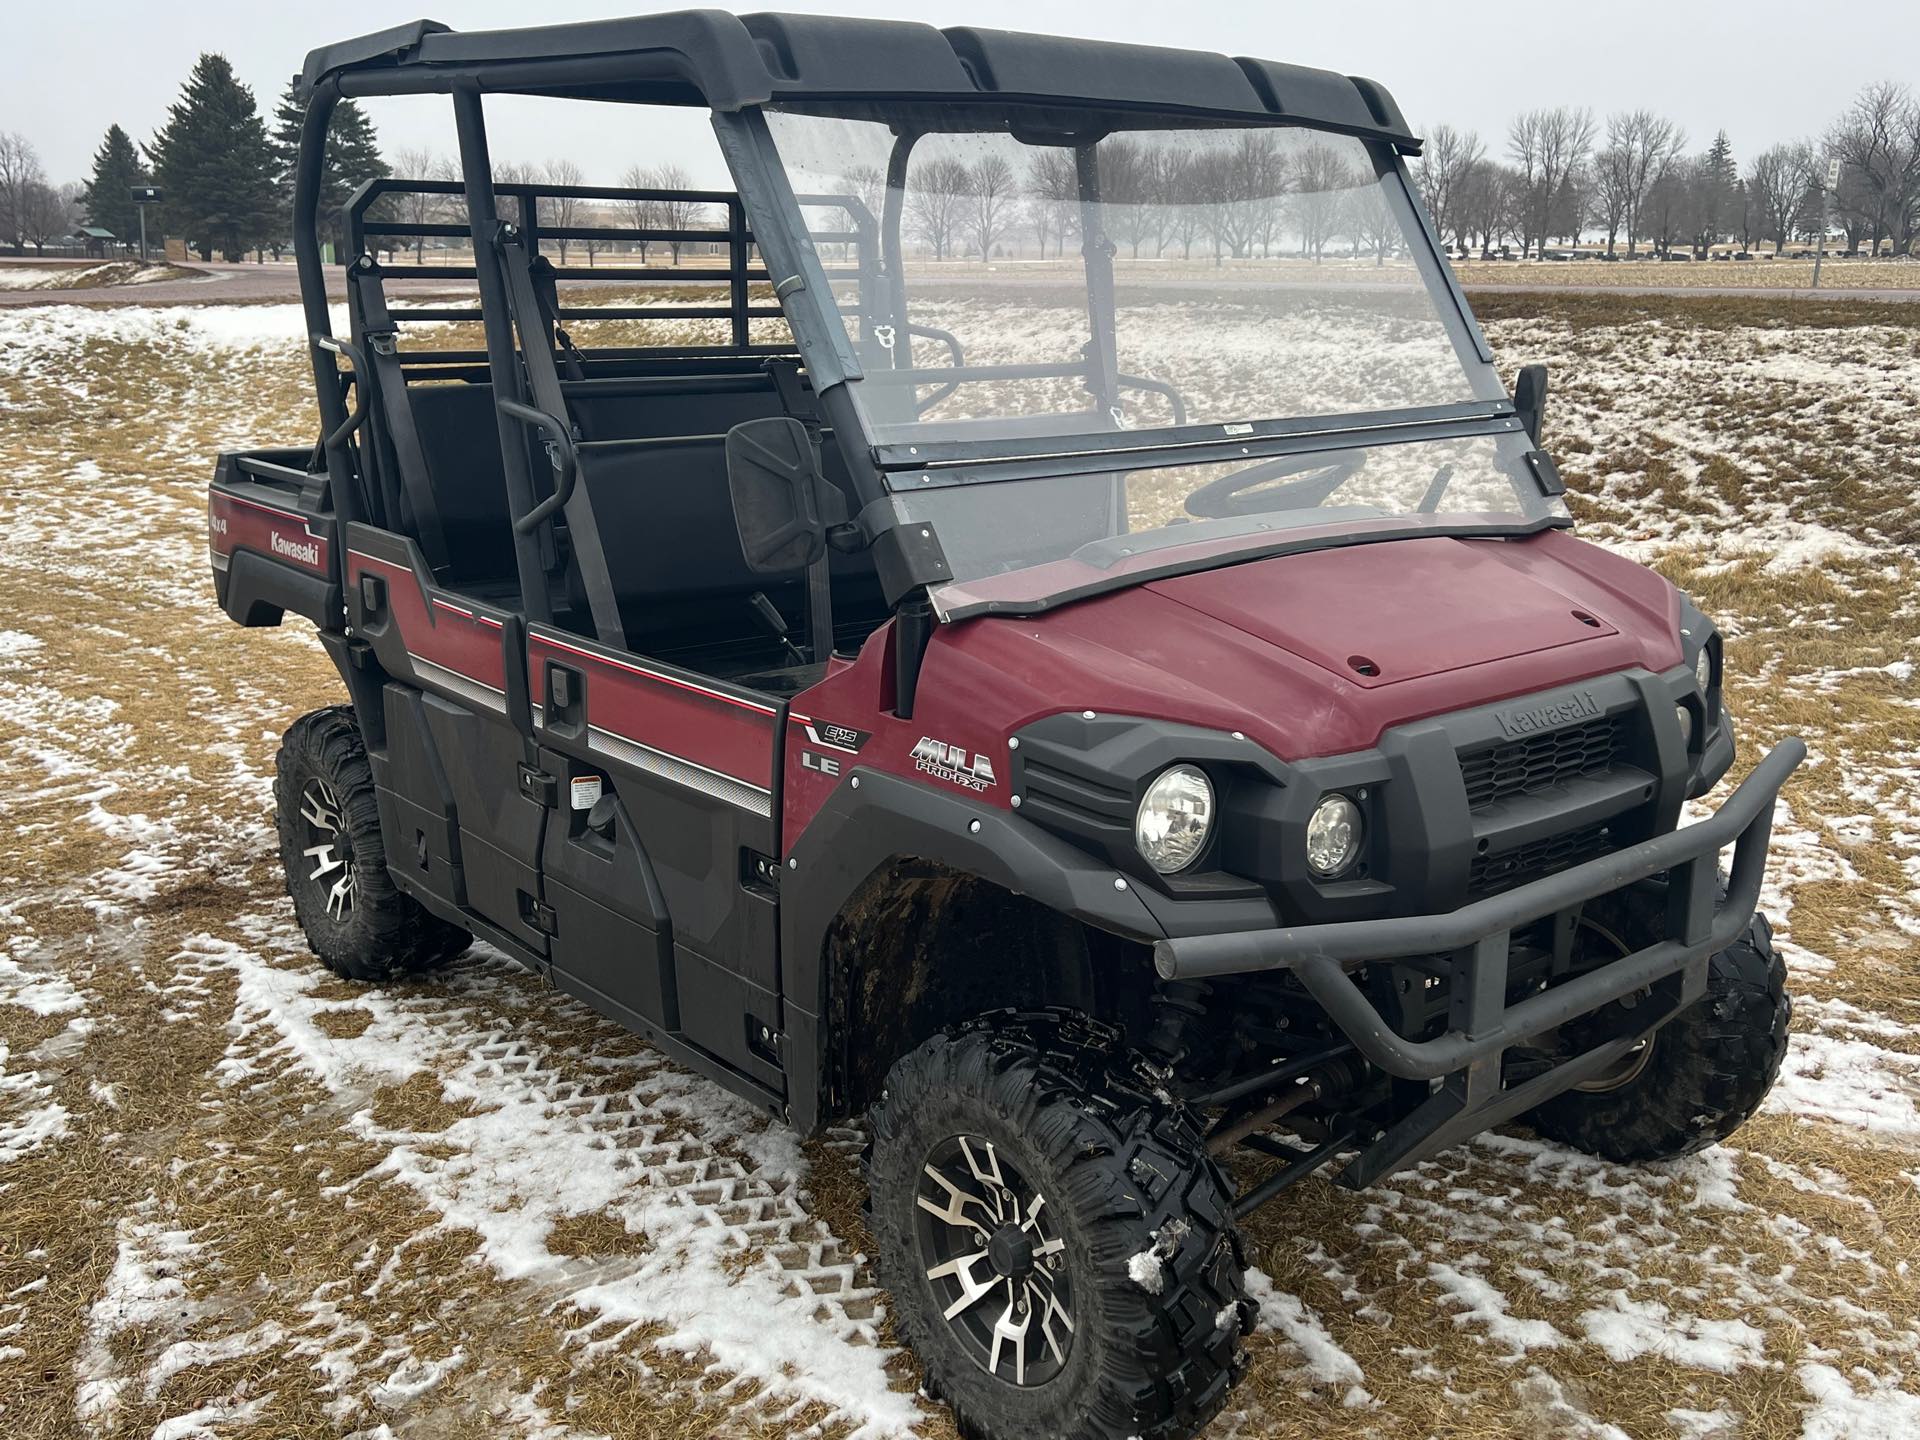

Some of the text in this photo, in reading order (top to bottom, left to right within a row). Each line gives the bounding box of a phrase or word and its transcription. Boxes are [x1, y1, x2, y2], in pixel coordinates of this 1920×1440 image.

[211, 515, 227, 535] 4x4
[270, 530, 319, 565] Kawasaki
[1495, 689, 1601, 737] Kawasaki
[802, 752, 840, 776] LE
[909, 736, 997, 785] MULE
[916, 759, 988, 792] PRO-FXT
